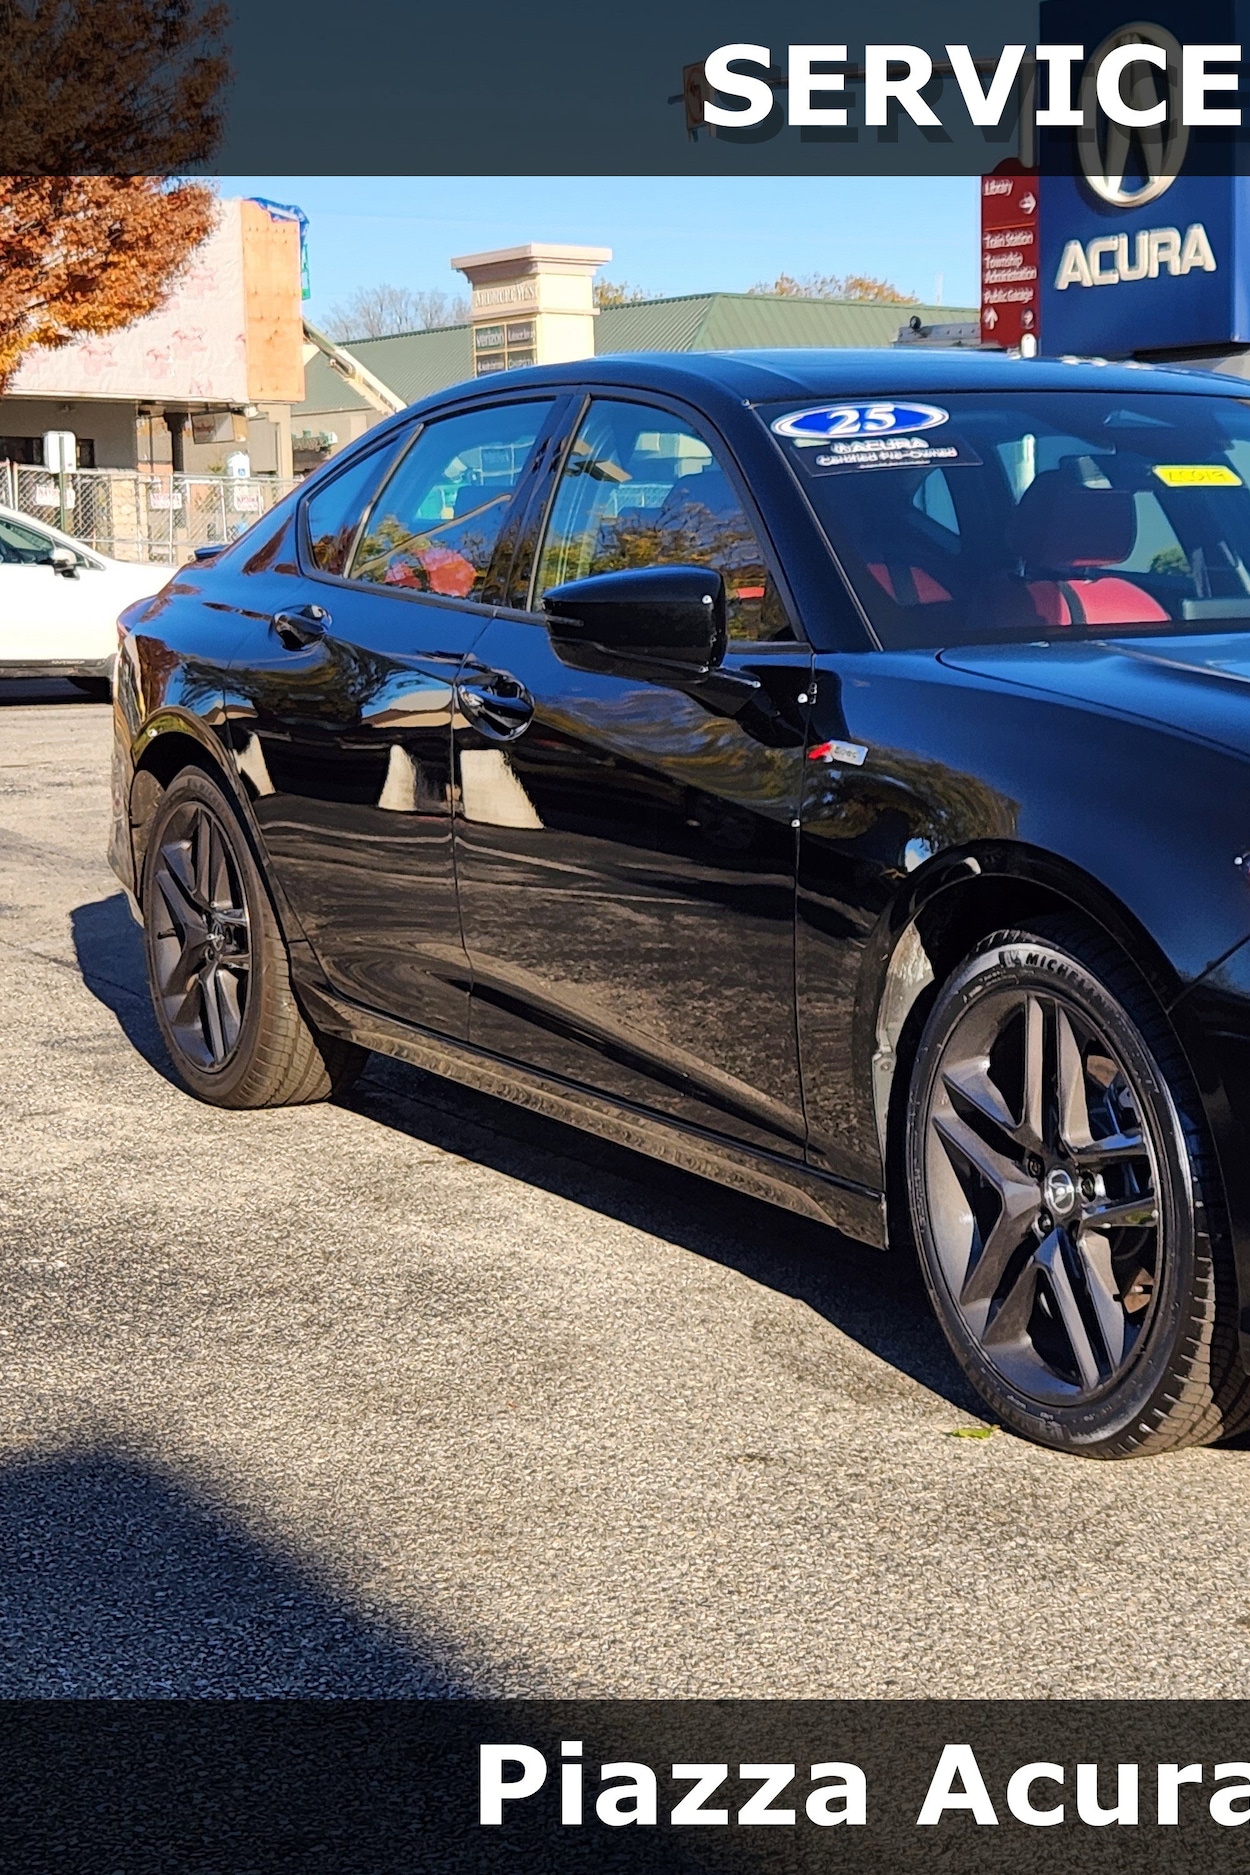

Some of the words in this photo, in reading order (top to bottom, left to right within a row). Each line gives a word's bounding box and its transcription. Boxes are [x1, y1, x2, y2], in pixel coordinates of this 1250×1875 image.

[984, 179, 1014, 197] Library
[984, 232, 1005, 249] Train
[1005, 230, 1034, 247] Station
[984, 252, 1024, 270] Township
[1055, 223, 1217, 291] ACURA
[984, 267, 1037, 284] Administration
[984, 288, 1008, 304] Public
[1008, 286, 1034, 304] Garage
[829, 405, 896, 434] 25
